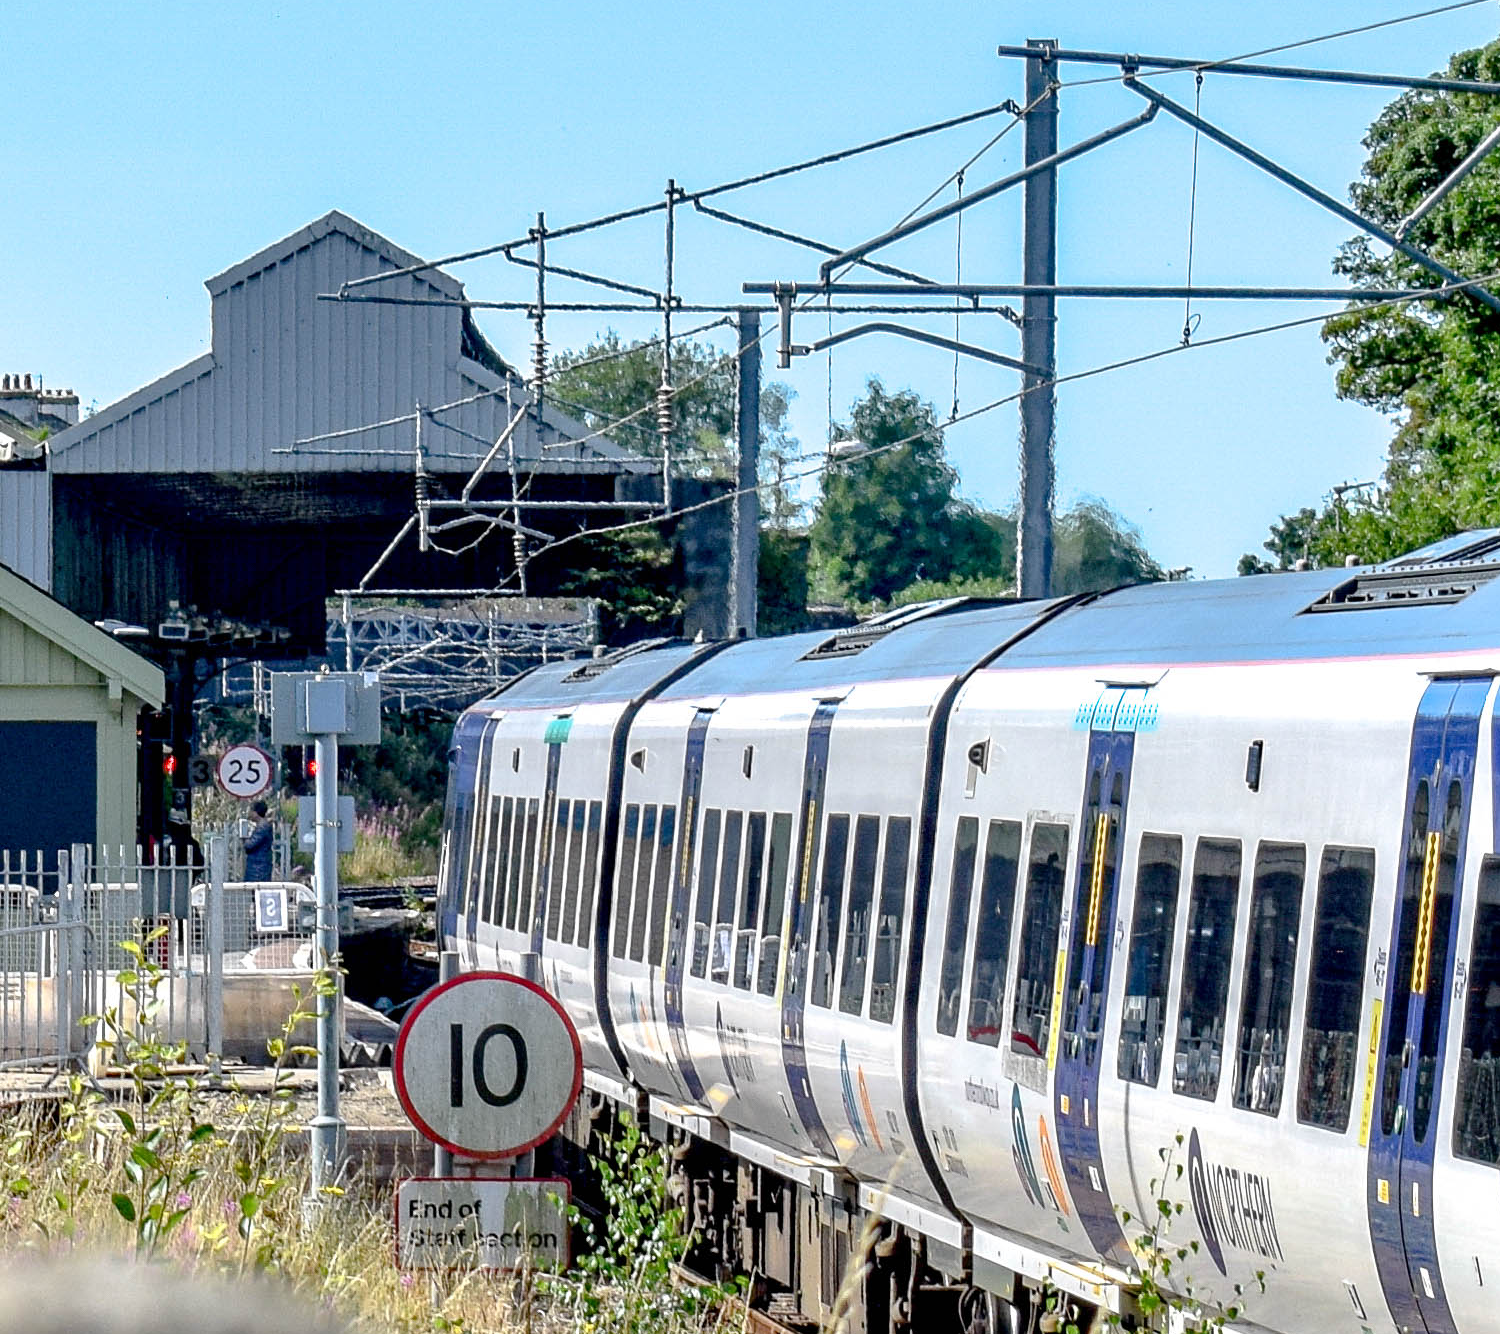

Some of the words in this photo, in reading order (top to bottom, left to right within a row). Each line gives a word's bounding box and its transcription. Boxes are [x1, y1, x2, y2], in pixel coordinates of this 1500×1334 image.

[192, 755, 210, 783] 3
[228, 759, 262, 785] 25
[450, 1023, 529, 1108] 10
[408, 1199, 453, 1219] End
[458, 1199, 482, 1219] of
[1206, 1160, 1285, 1263] NORTHERN
[474, 1229, 558, 1249] secton
